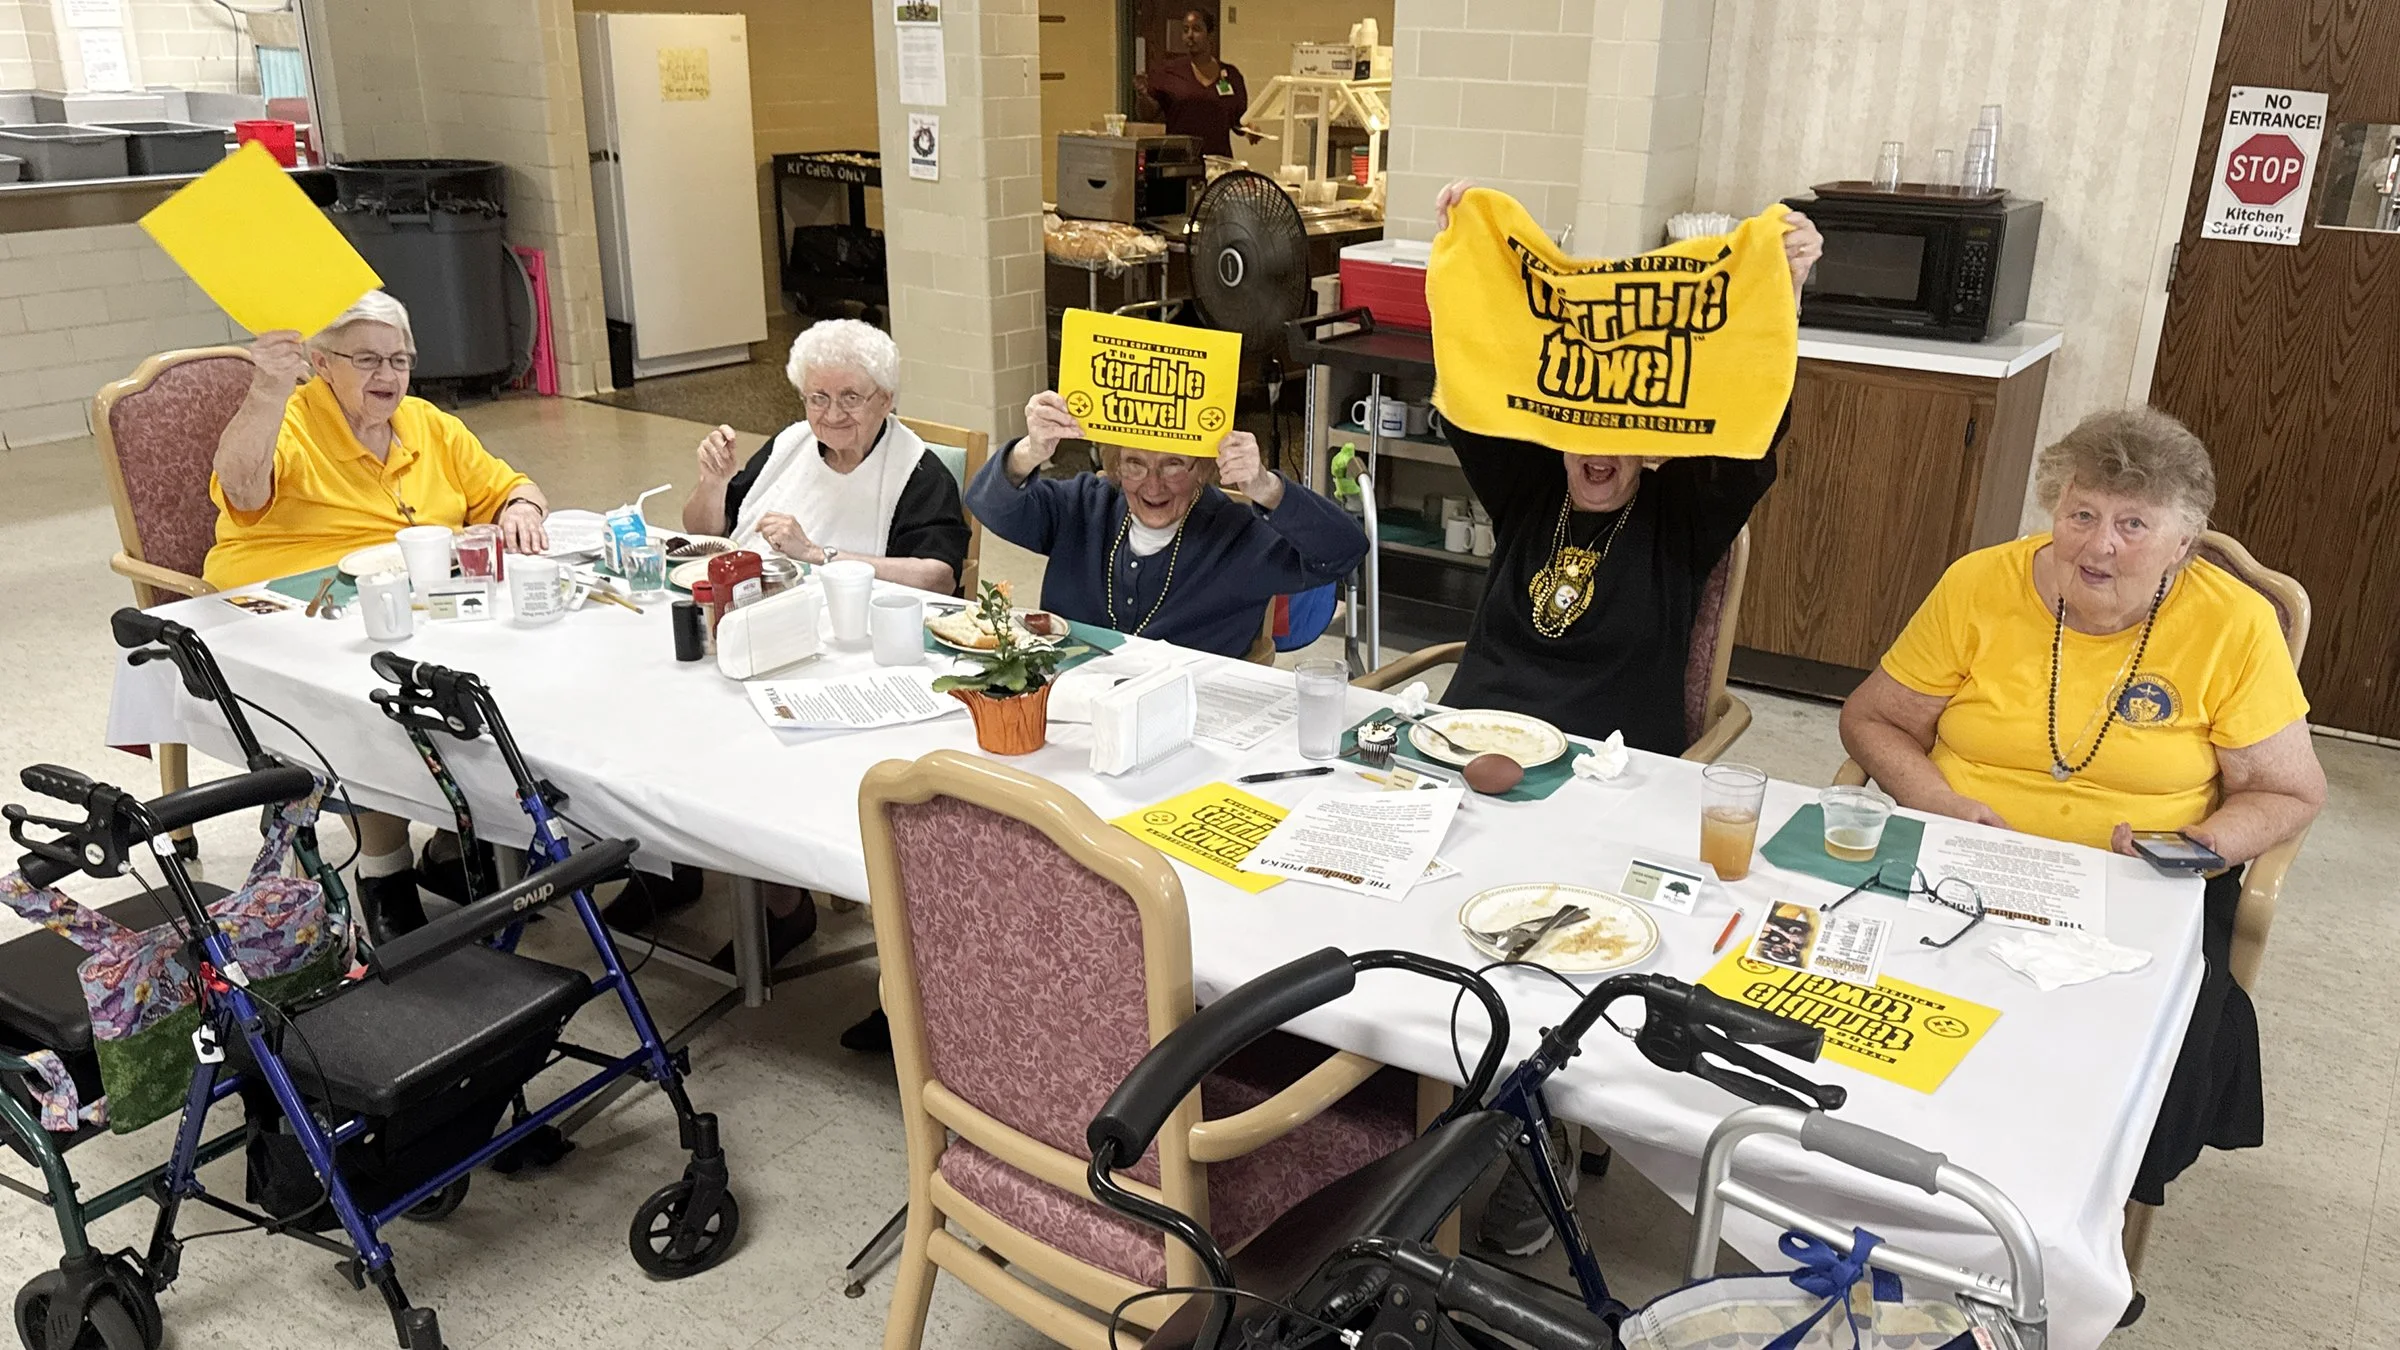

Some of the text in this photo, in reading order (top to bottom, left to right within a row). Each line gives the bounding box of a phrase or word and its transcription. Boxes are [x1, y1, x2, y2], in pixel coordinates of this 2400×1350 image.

[2265, 94, 2292, 109] NO
[2229, 110, 2322, 130] ENTRANCE!
[838, 167, 867, 182] ONLY
[2229, 154, 2300, 184] STOP
[2225, 207, 2284, 224] Kitchen
[2211, 221, 2292, 241] Staff Only!
[1096, 335, 1205, 358] MYRON COPE'S OFFICIAL
[1110, 349, 1135, 360] The
[1091, 351, 1205, 400] terrible
[1537, 326, 1691, 408] towel
[1102, 391, 1187, 430] towel
[1514, 398, 1707, 433] A PITTSBURGH ORIGINAL
[1100, 424, 1156, 436] PITTSBURGH
[1157, 430, 1199, 441] ORIGINAL
[1192, 805, 1277, 847] terri
[1171, 821, 1257, 863] towe
[1260, 858, 1392, 891] THE Steelers POLKA
[513, 882, 555, 913] drive
[1781, 972, 1913, 1025] towel
[1743, 981, 1914, 1051] terrible
[1836, 1031, 1875, 1049] The
[1842, 1041, 1892, 1063] MYRON
